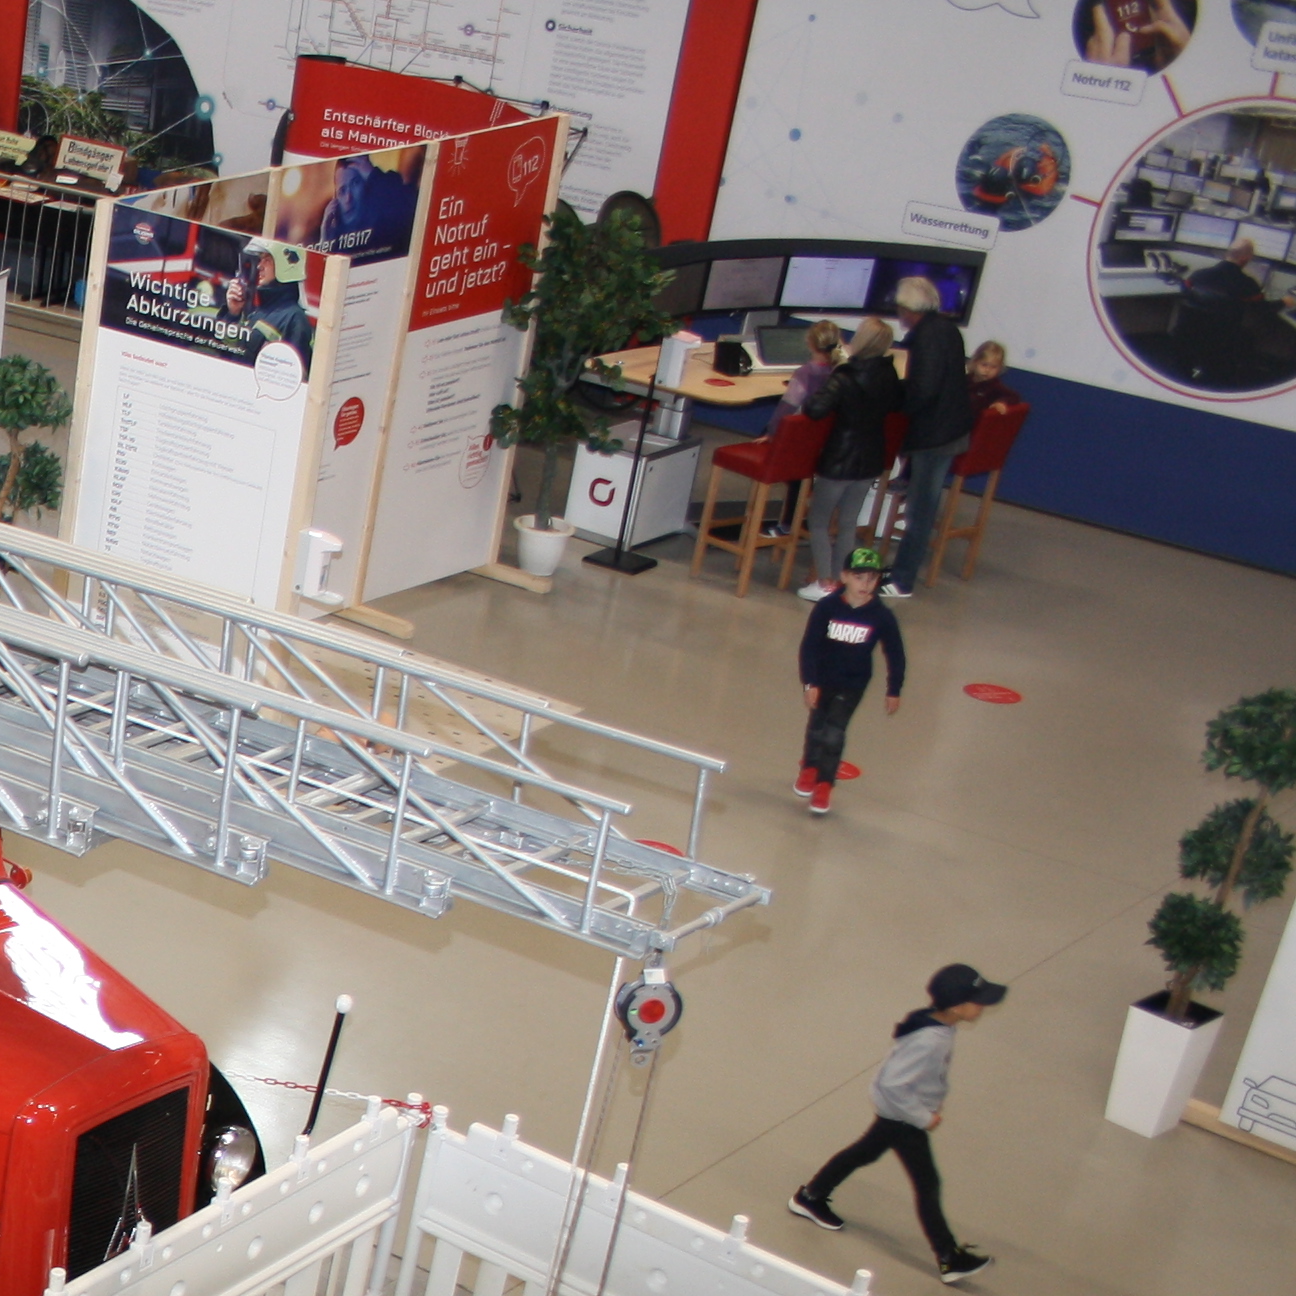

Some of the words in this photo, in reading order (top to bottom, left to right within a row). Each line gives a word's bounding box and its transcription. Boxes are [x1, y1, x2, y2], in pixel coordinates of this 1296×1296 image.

[1116, 2, 1141, 18] 112
[1073, 72, 1111, 88] Notruf
[1113, 79, 1132, 92] 112
[321, 127, 344, 140] als
[323, 108, 411, 134] Entschärfter
[414, 124, 450, 140] Block
[522, 157, 540, 175] 112
[438, 197, 464, 219] Ein
[434, 214, 489, 246] Notruf
[909, 212, 990, 239] Wasserrettung
[338, 229, 372, 250] 116117
[429, 247, 468, 278] geht
[473, 243, 498, 264] ein
[129, 271, 210, 308] Wichtige
[425, 277, 457, 298] und
[459, 261, 506, 296] jetzt?
[125, 316, 137, 326] Die
[138, 320, 193, 343] Geheimsprache
[194, 335, 208, 345] der
[126, 294, 252, 342] Abkürzungen
[827, 620, 871, 644] MARVEL
